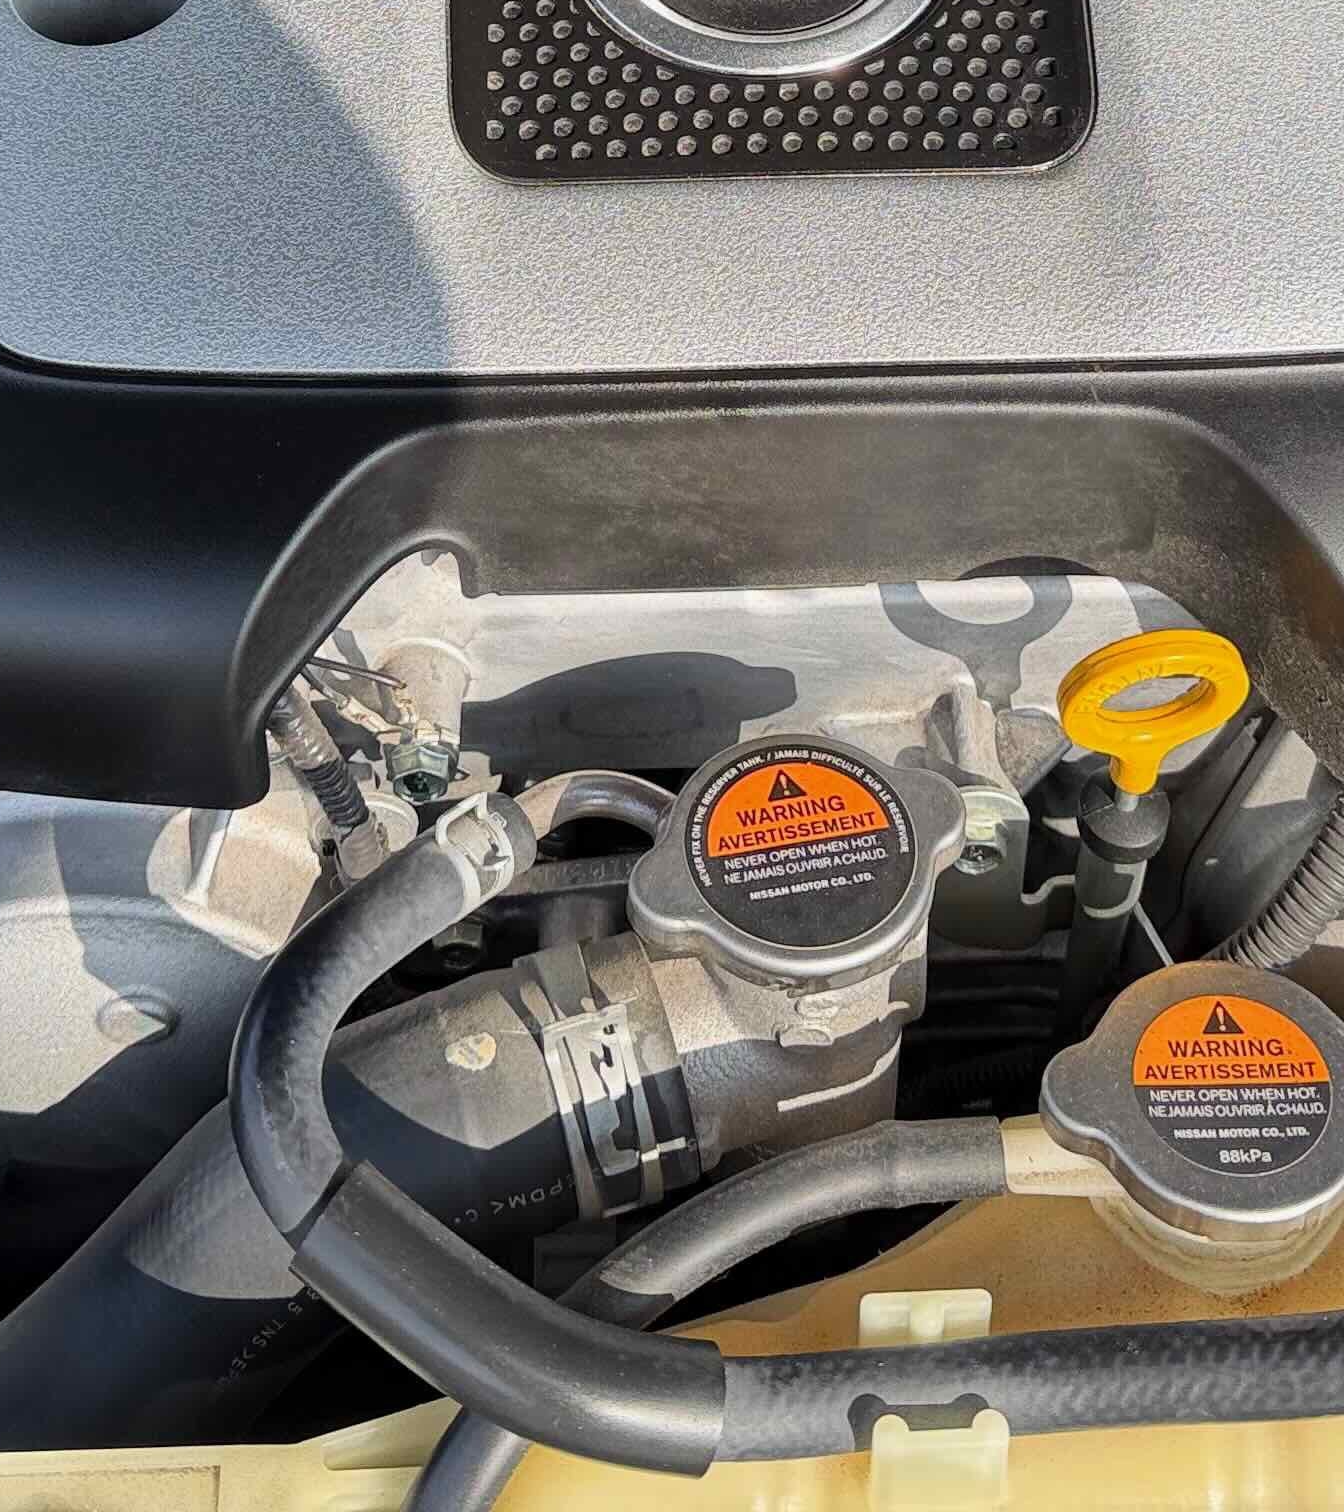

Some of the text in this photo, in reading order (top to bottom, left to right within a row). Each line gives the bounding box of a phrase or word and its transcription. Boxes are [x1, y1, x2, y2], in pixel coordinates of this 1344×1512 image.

[774, 749, 809, 760] JAMAIS
[863, 773, 883, 792] SUR
[879, 789, 892, 802] LE
[694, 804, 707, 823] THE
[736, 795, 846, 827] WARNING
[692, 824, 701, 839] ON
[718, 811, 875, 852] AVERTISSEMENT
[692, 840, 702, 855] FIX
[724, 853, 767, 871] NEVER
[769, 847, 807, 864] OPEN
[807, 840, 850, 857] WHEN
[693, 855, 713, 887] NEVER
[724, 871, 741, 885] NE
[742, 864, 786, 882] JAMAIS
[786, 857, 832, 875] OUVRIR
[842, 847, 889, 865] CHAUD.
[749, 885, 791, 901] NISSAN
[791, 879, 830, 894] MOTOR
[853, 872, 875, 884] LTD.
[1145, 1061, 1316, 1080] AVERTISSEMENT
[1150, 1088, 1321, 1102] NEVER OPEN WHEN HOT.
[1149, 1105, 1166, 1118] NE
[1166, 1105, 1214, 1118] JAMAIS
[1214, 1104, 1266, 1117] OUVRIR
[1276, 1102, 1328, 1116] CHAUD.
[1173, 1126, 1311, 1140] NISSAN MOTOR CO., LTD.
[1219, 1149, 1272, 1164] 88kPa
